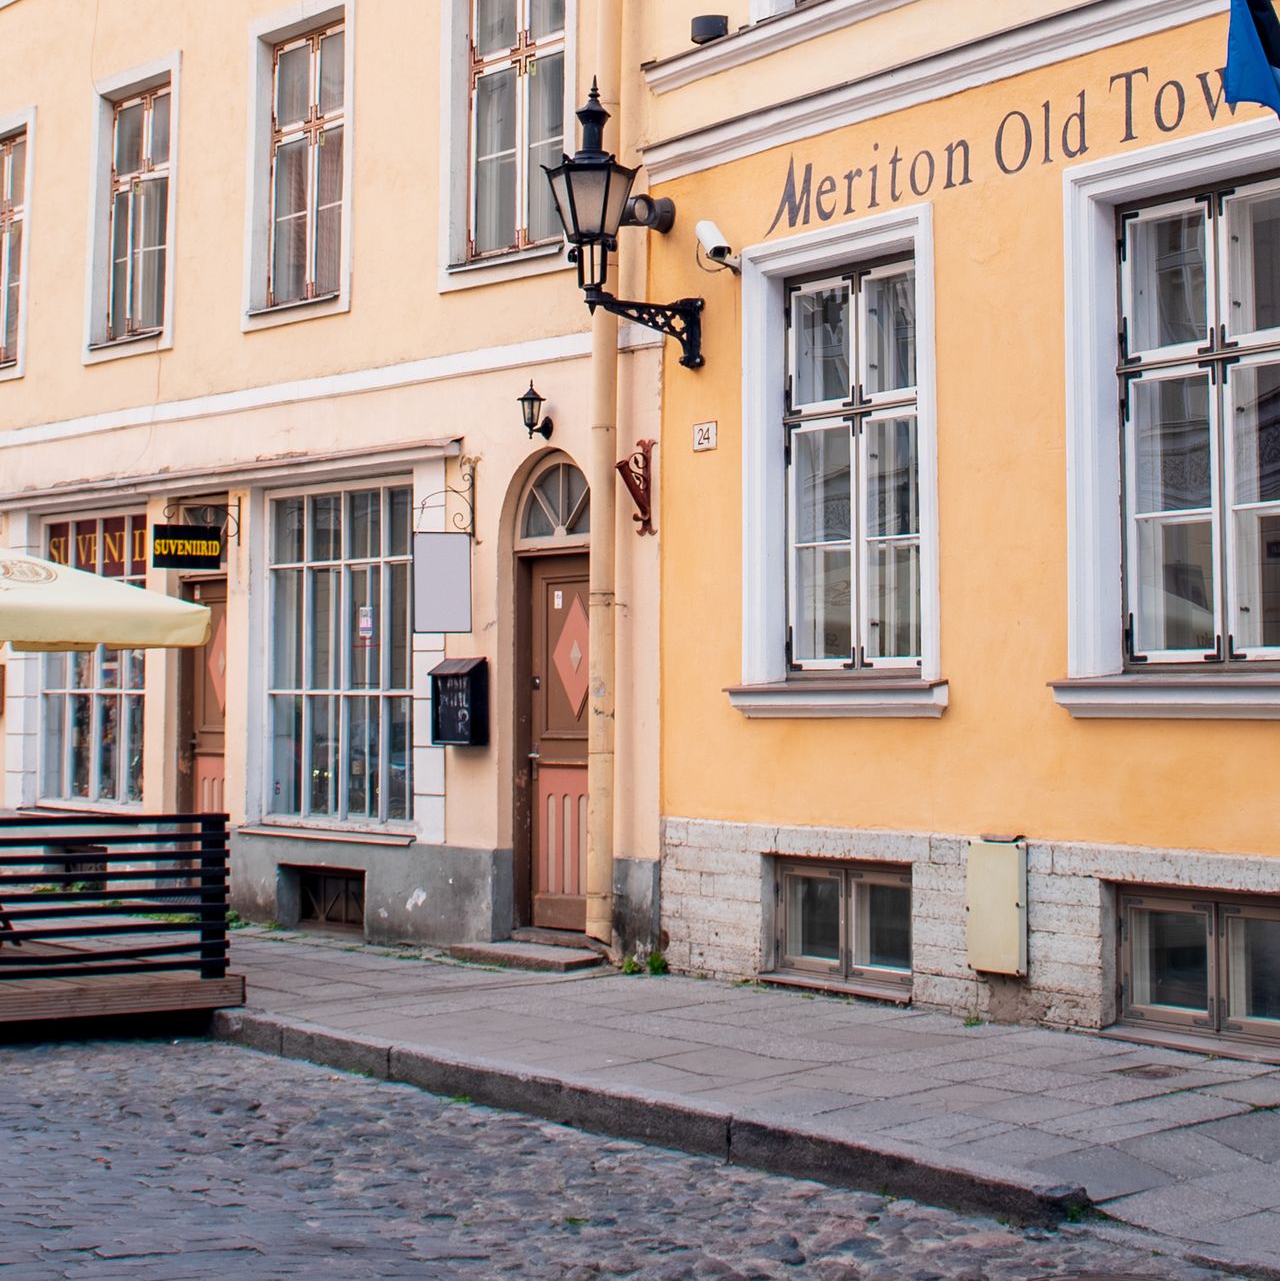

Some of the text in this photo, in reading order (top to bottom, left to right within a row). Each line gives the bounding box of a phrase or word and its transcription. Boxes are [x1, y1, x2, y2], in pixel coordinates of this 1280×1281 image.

[766, 138, 974, 238] Meriton
[995, 89, 1090, 175] Old
[1109, 65, 1263, 144] Tow
[697, 426, 711, 446] 24
[153, 539, 220, 556] SUVENIIRID
